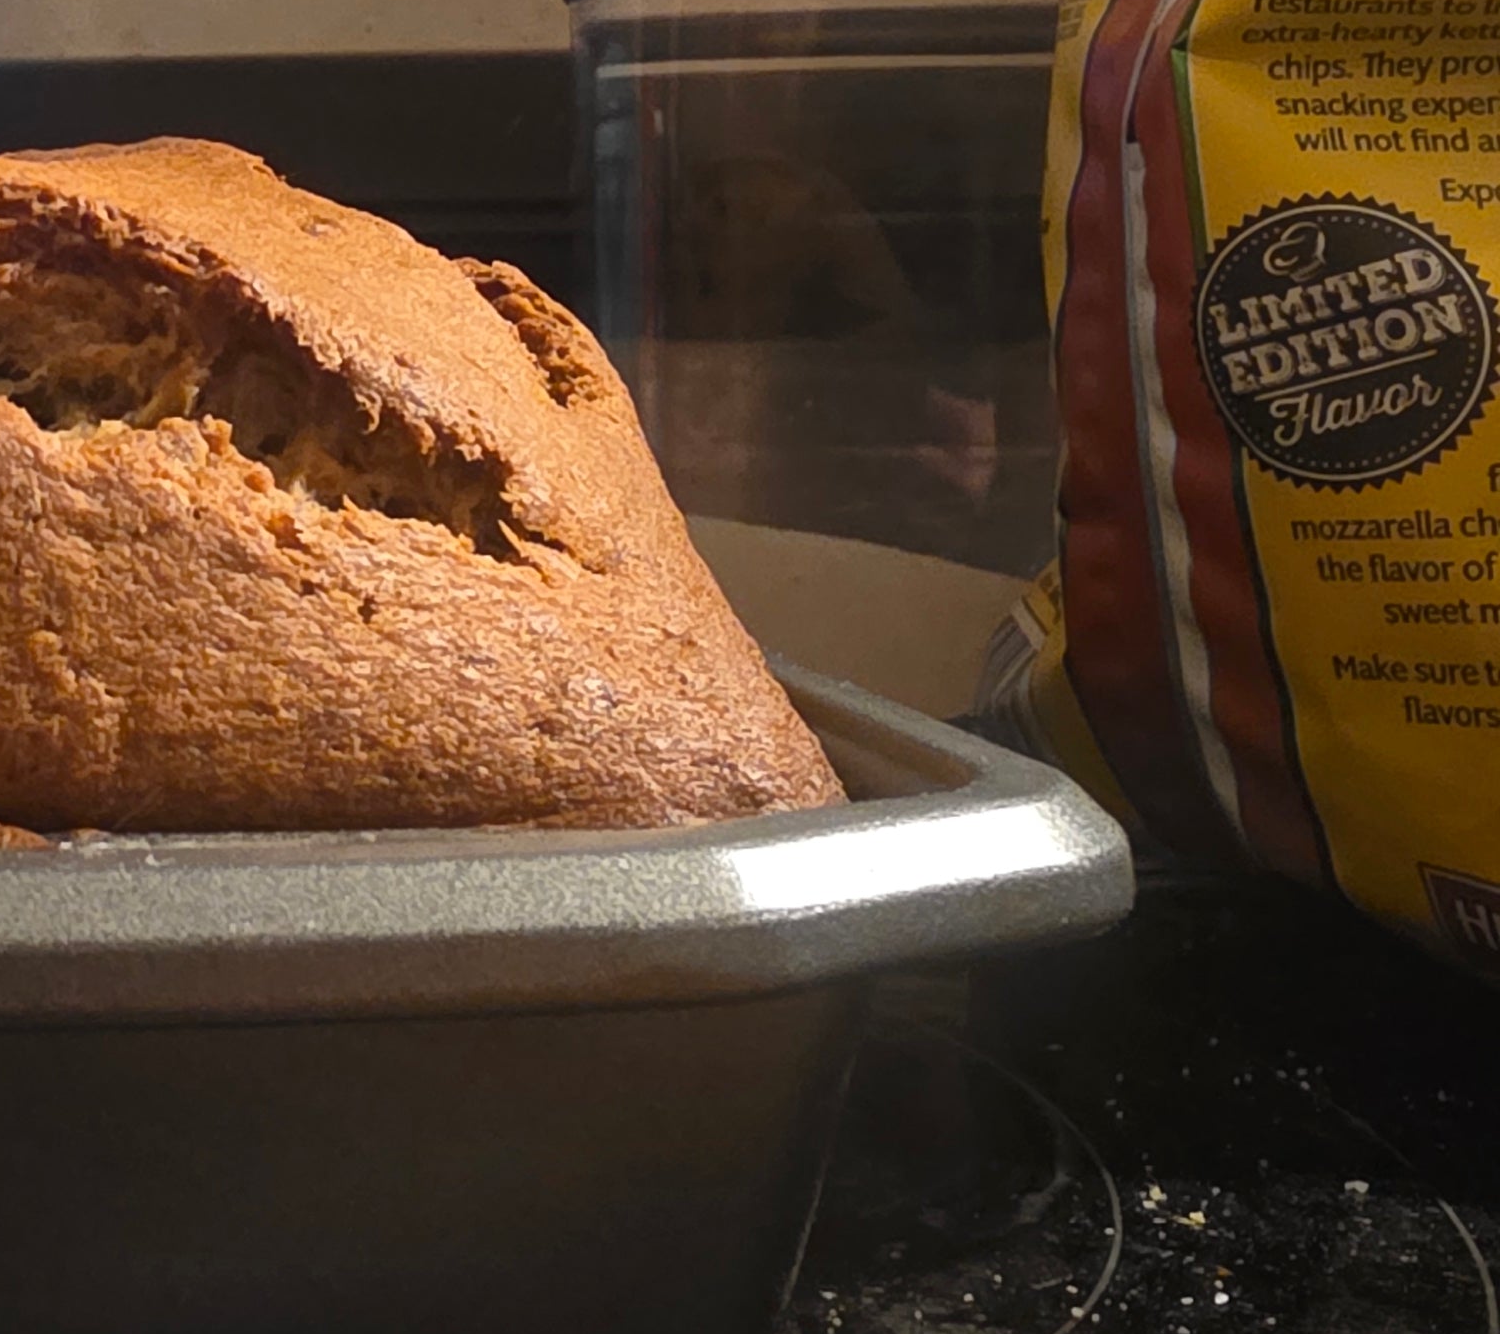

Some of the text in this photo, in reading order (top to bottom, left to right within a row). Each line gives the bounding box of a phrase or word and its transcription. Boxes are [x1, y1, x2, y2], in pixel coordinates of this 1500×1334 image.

[1240, 20, 1436, 47] extra-hearty
[1267, 50, 1355, 87] chips.
[1362, 50, 1434, 86] They
[1274, 89, 1409, 124] snacking
[1293, 125, 1349, 153] will
[1353, 128, 1407, 153] not
[1411, 127, 1471, 153] find
[1208, 247, 1448, 347] LIMITED
[1221, 293, 1469, 395] EDITION
[1268, 372, 1444, 447] Flavor
[1291, 507, 1500, 542] mozzarella ch
[1316, 549, 1499, 584] the flavor of
[1383, 598, 1474, 625] sweet
[1332, 652, 1409, 682] Make
[1413, 660, 1480, 686] sure
